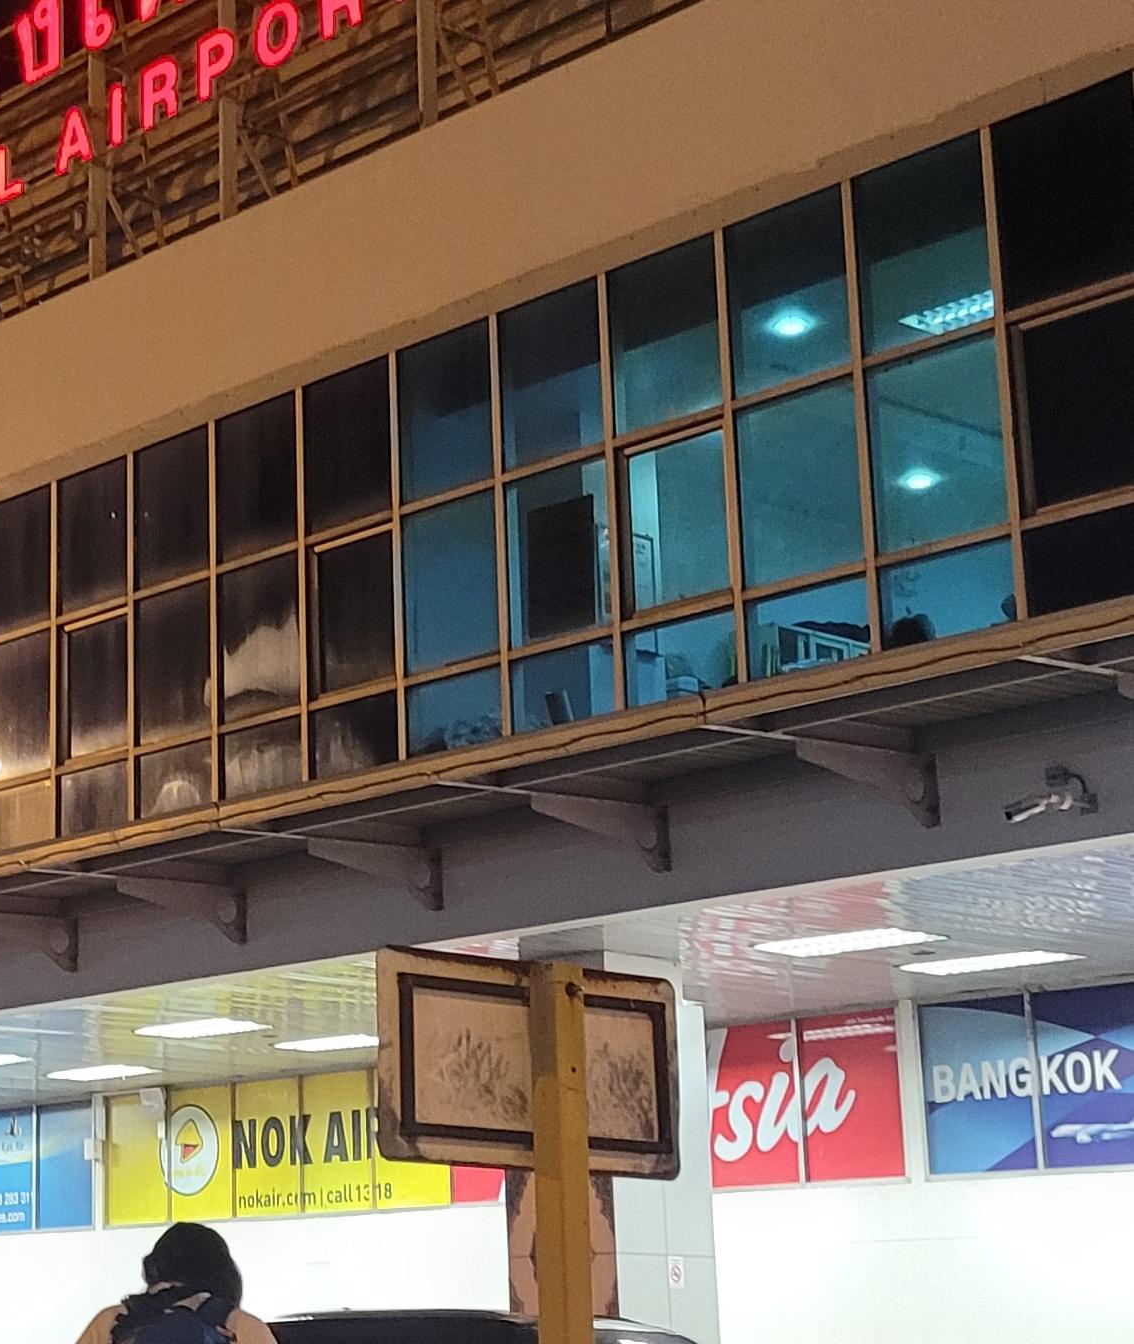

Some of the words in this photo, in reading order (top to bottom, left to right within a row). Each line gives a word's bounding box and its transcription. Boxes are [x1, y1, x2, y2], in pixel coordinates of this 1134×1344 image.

[708, 1028, 856, 1162] sia
[932, 1048, 1122, 1104] BANGKOK
[232, 1113, 313, 1169] NOK
[327, 1183, 353, 1203] call
